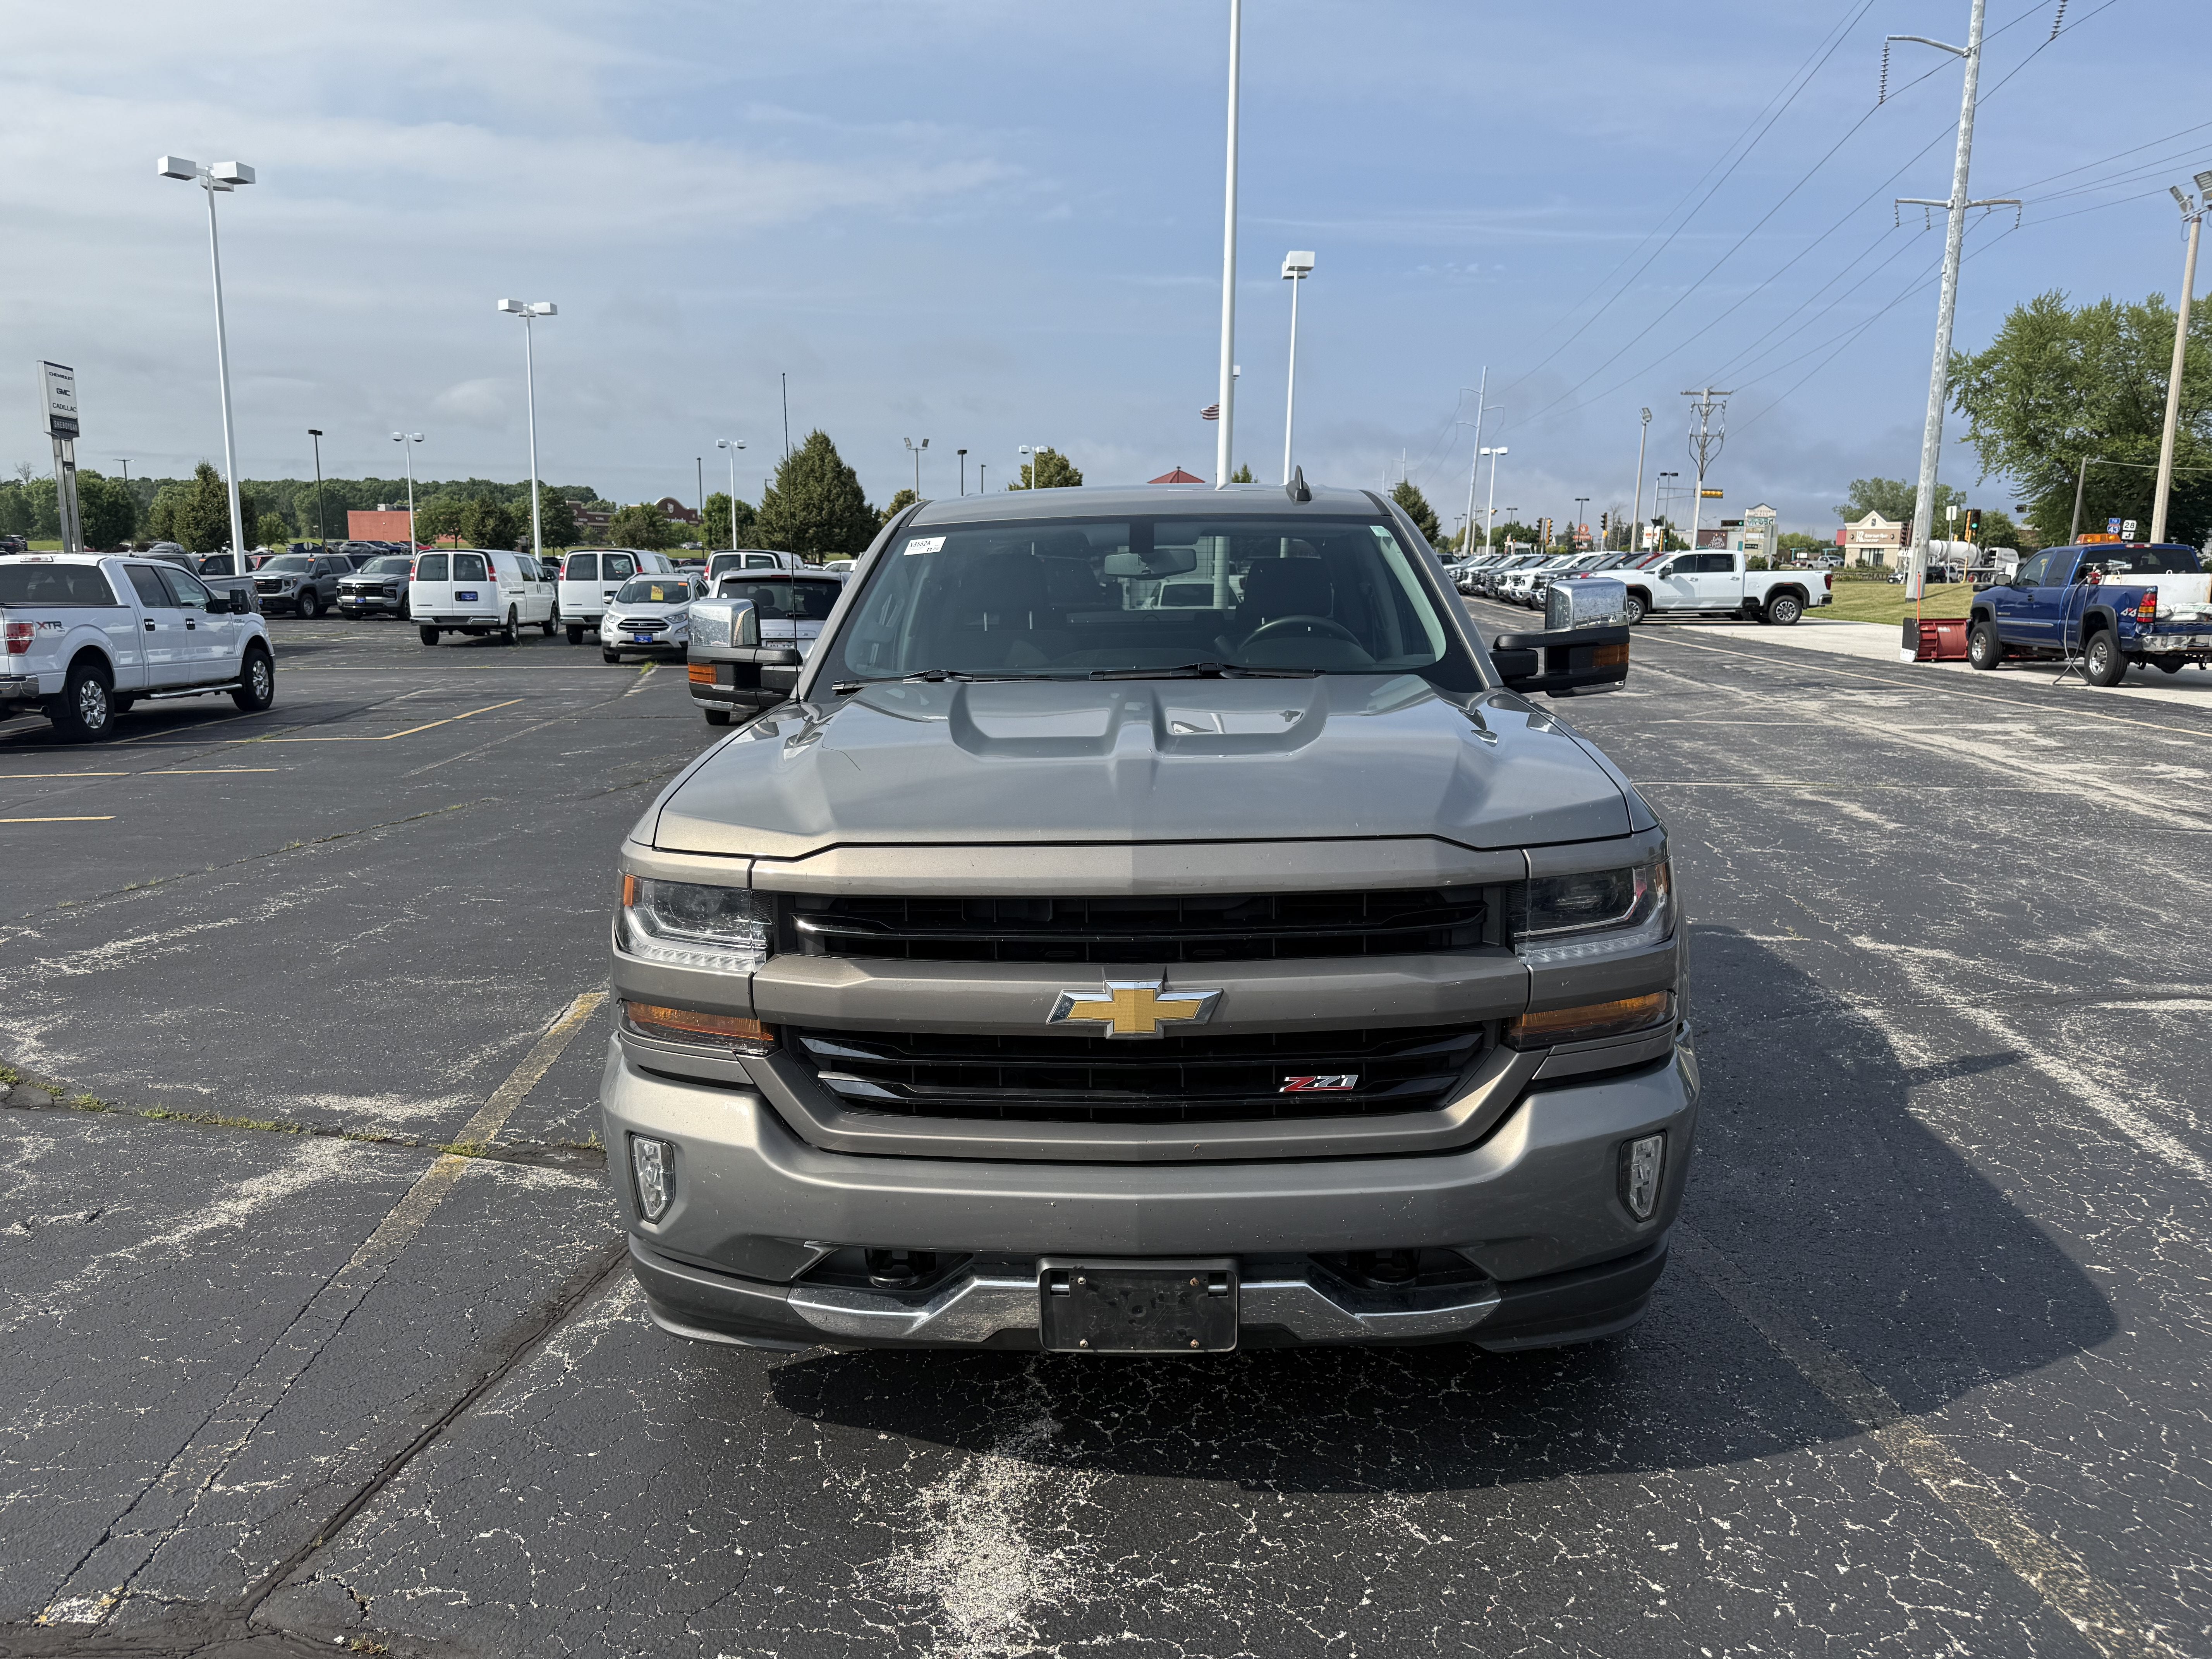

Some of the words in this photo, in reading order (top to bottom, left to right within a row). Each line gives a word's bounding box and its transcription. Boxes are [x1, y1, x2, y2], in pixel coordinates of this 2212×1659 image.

[49, 371, 73, 380] CHEVROLET
[56, 388, 70, 397] GMC
[52, 402, 77, 412] CADILLAC
[36, 621, 64, 630] XTR
[1279, 1075, 1358, 1092] Z71
